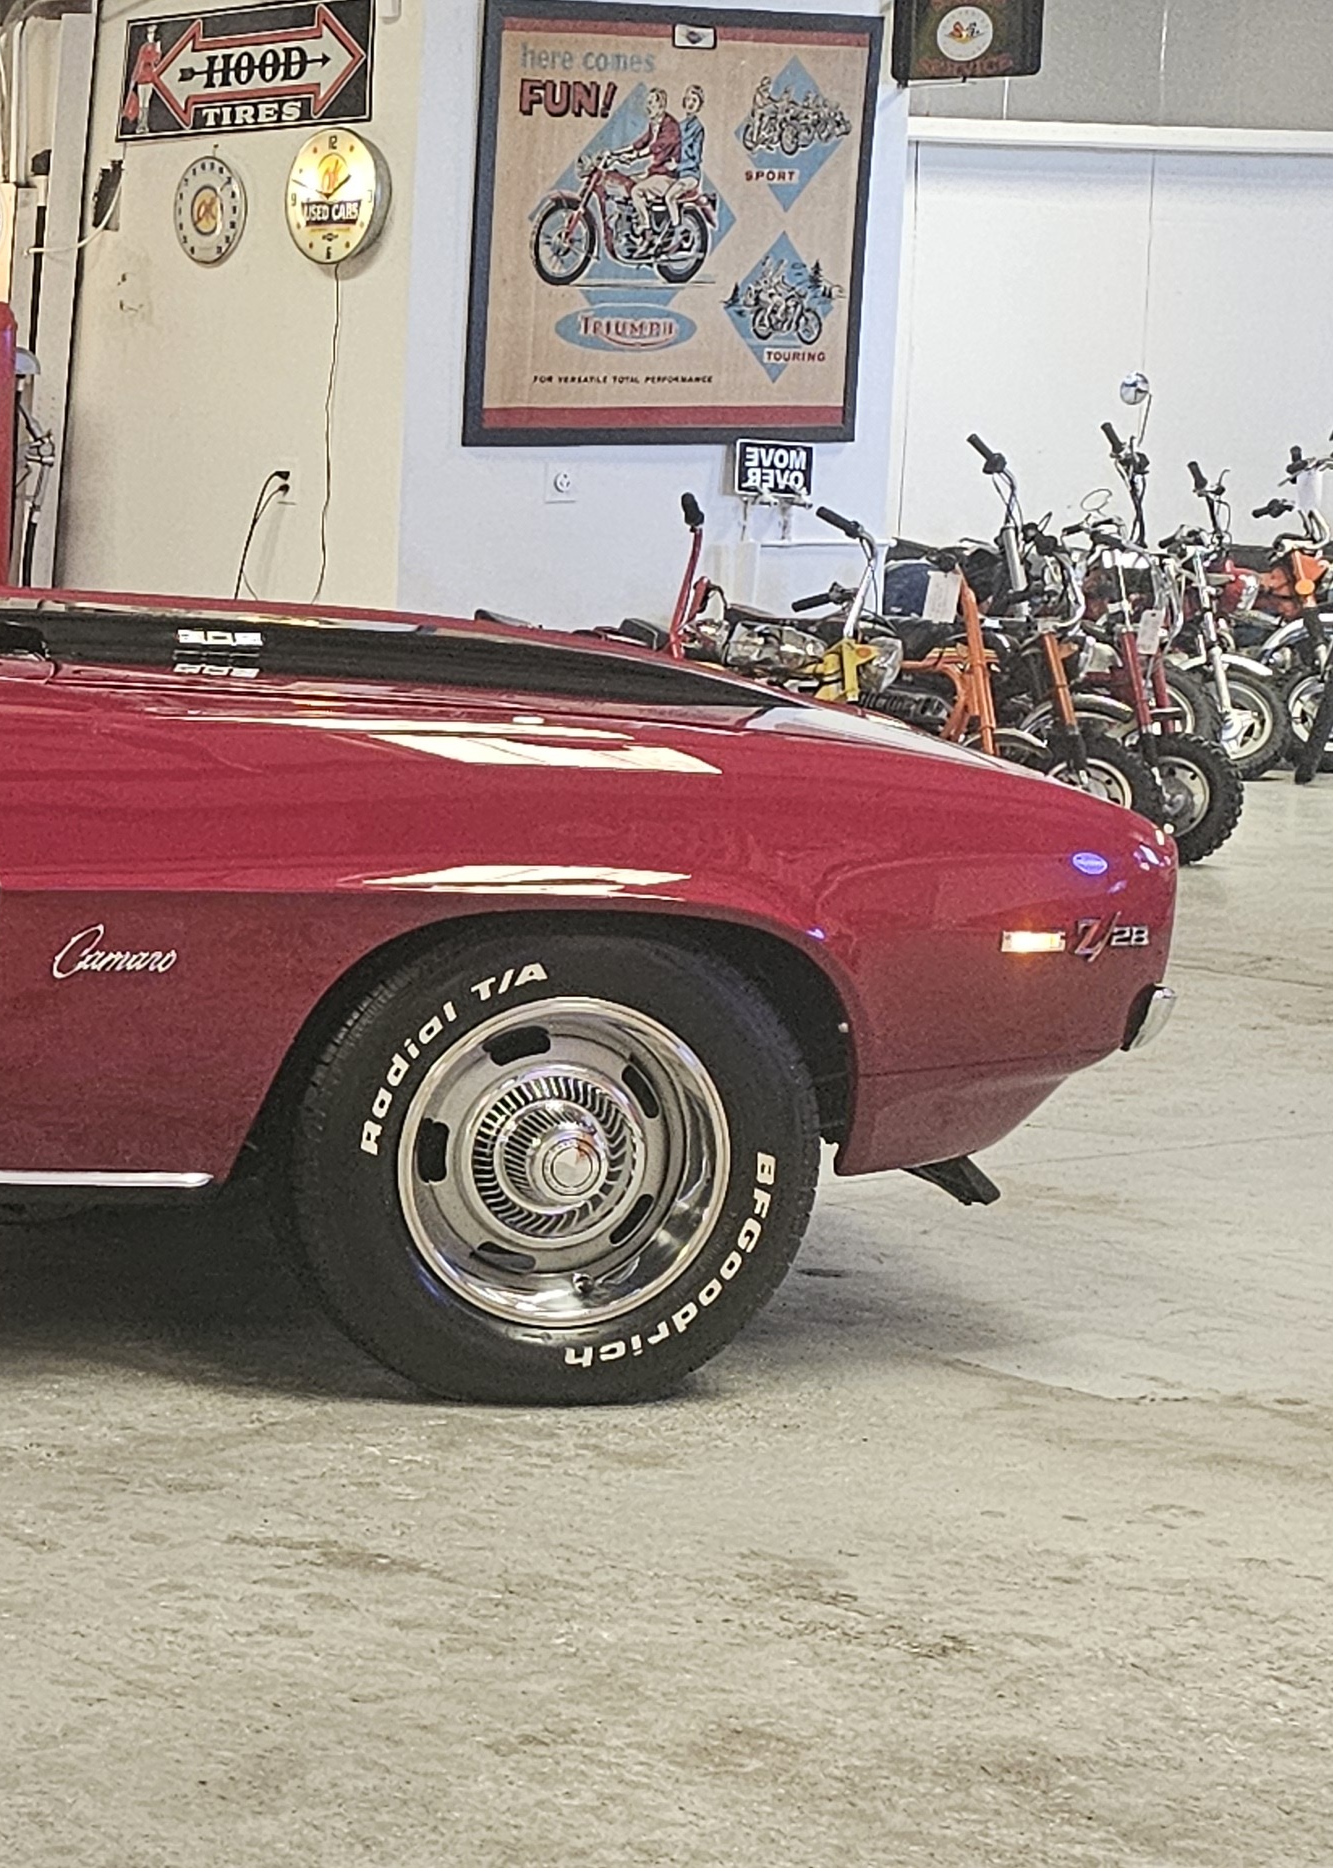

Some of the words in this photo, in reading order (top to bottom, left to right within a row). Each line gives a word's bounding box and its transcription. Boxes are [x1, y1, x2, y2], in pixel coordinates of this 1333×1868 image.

[203, 46, 308, 88] HOOD
[521, 42, 573, 70] here
[583, 51, 656, 73] comes
[519, 78, 618, 118] FUN!
[202, 101, 302, 127] TIRES
[744, 170, 797, 182] SPORT
[303, 203, 329, 221] USED
[331, 201, 359, 220] CARS
[579, 313, 677, 338] TRIUMPH
[766, 350, 826, 363] TOURING
[52, 924, 178, 979] Camaro
[359, 1000, 458, 1156] Radial
[470, 962, 549, 1002] T/A
[564, 1151, 777, 1368] BFGoodrich
